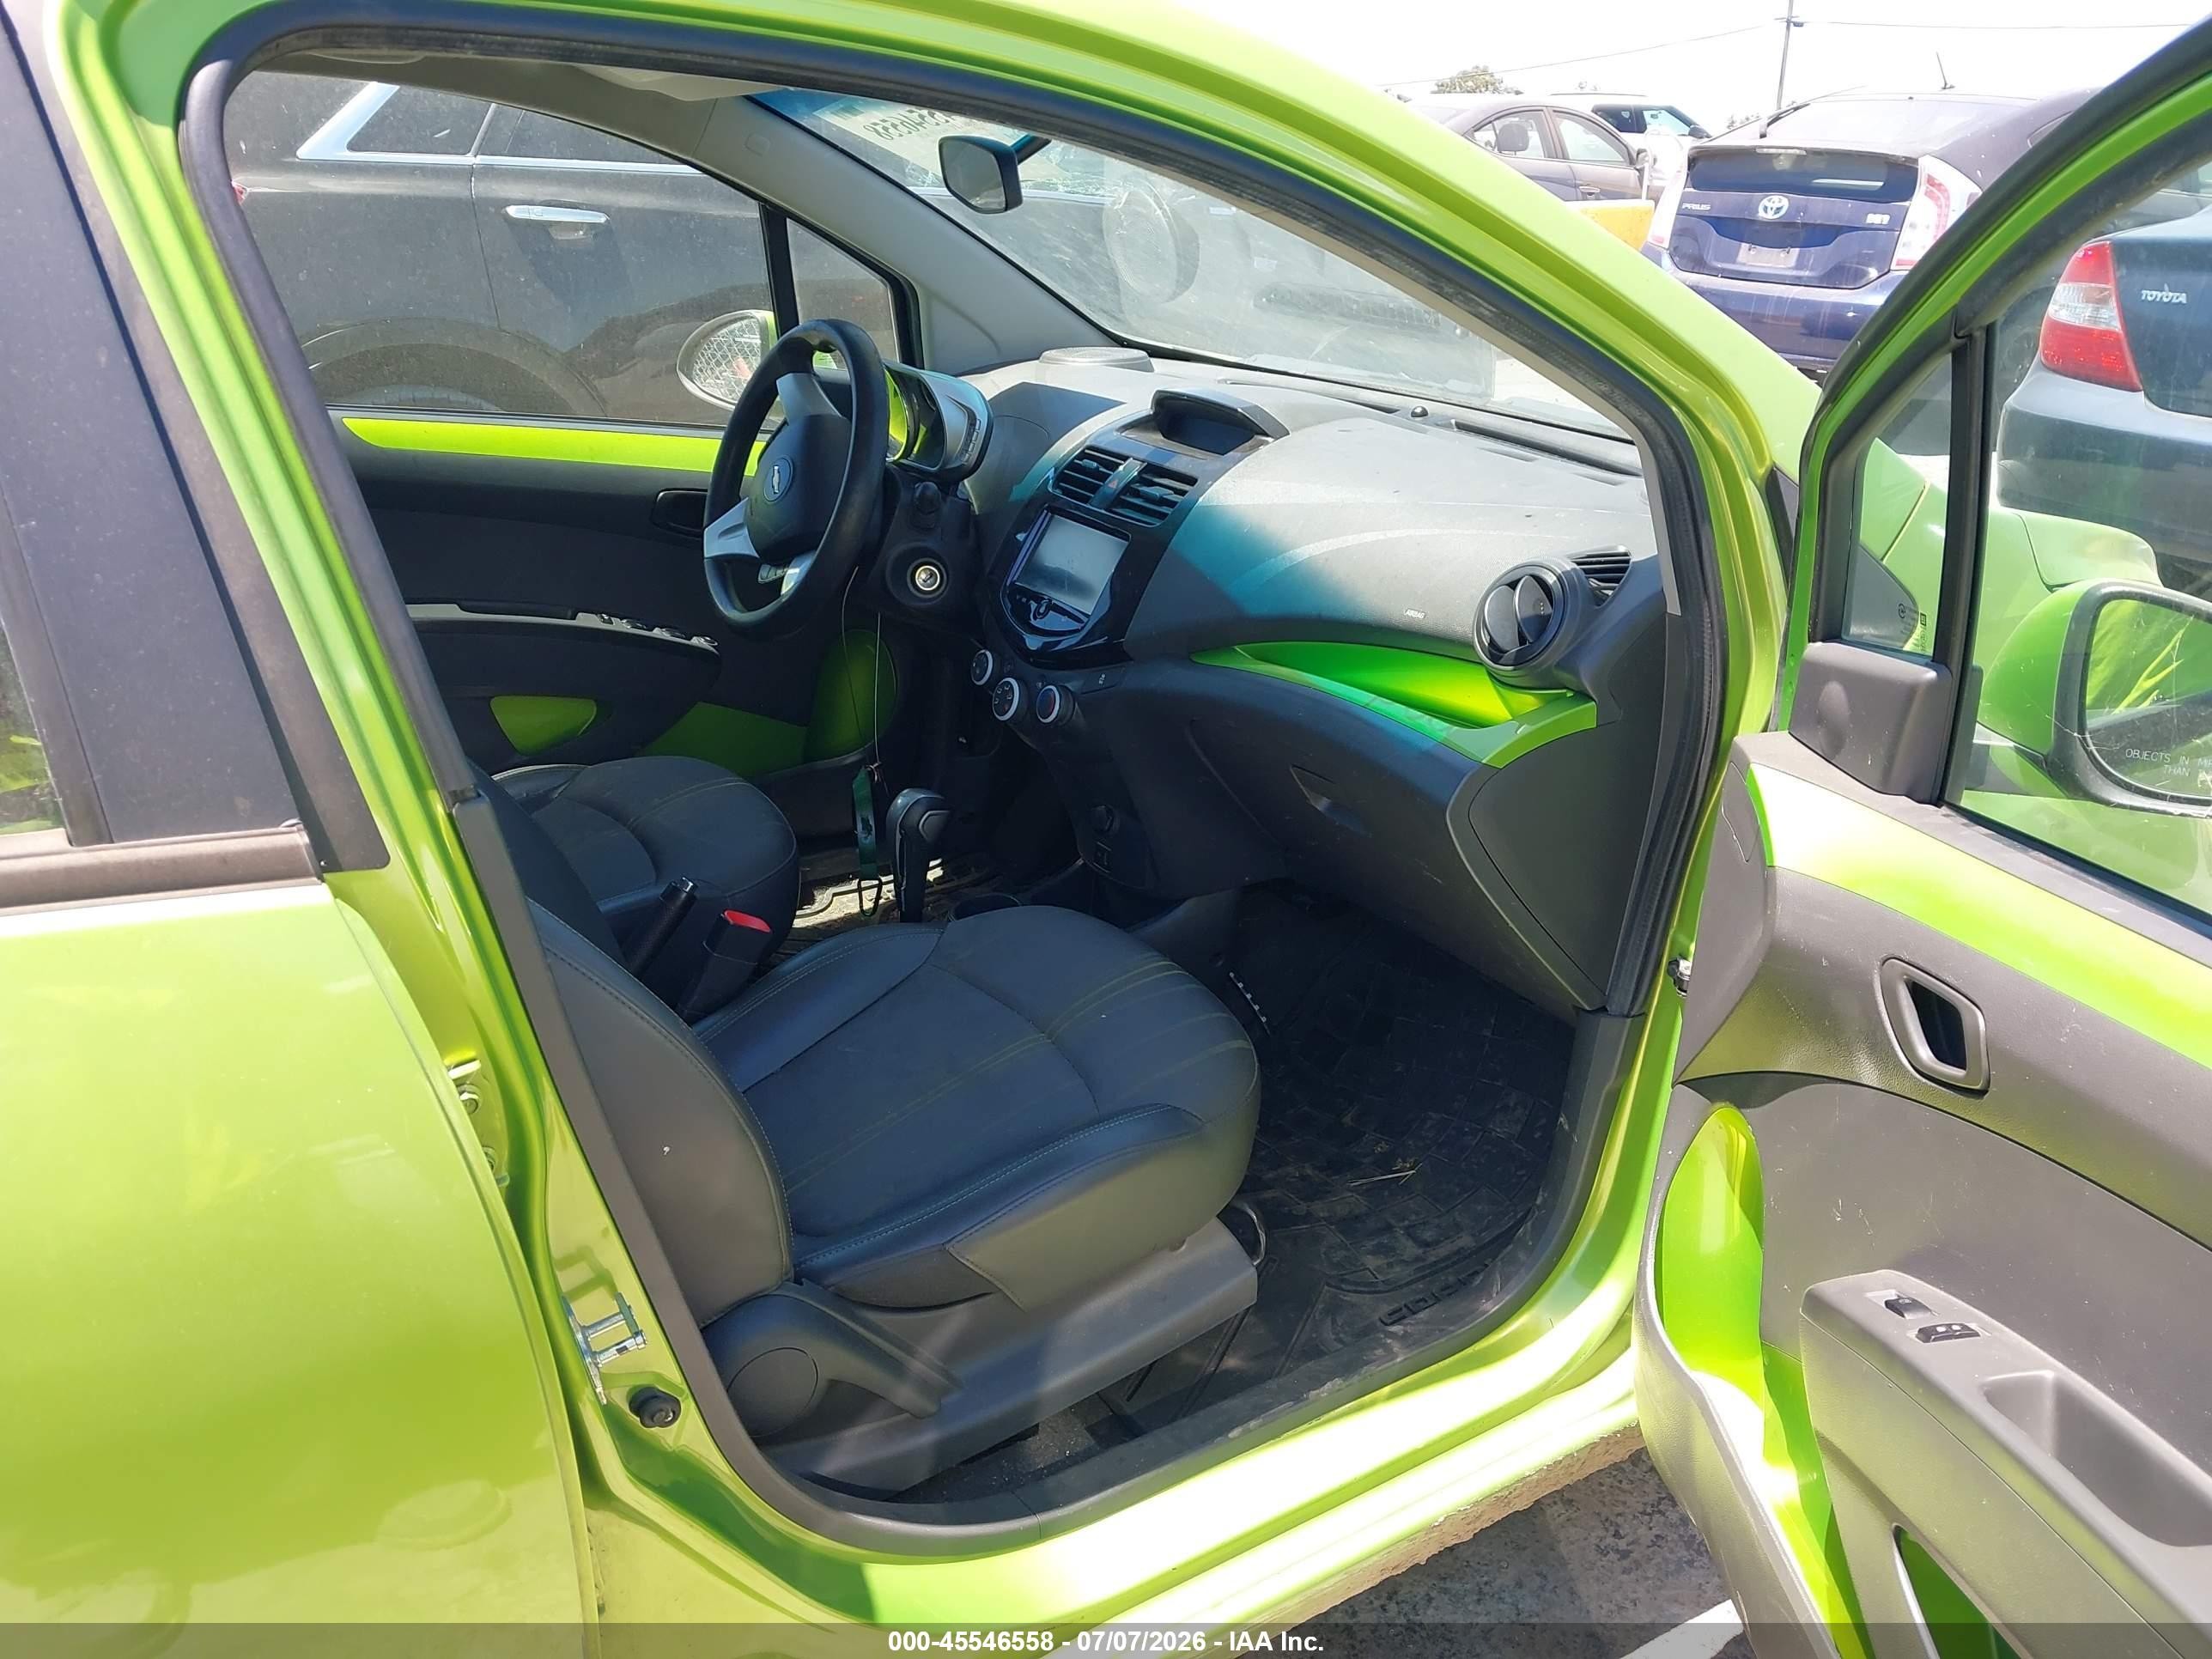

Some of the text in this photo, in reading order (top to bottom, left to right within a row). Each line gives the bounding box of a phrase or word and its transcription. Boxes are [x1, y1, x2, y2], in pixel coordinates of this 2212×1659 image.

[2141, 289, 2187, 303] TOYOTA
[1404, 609, 1425, 619] AIRBAG
[2125, 748, 2171, 763] OBJECTS
[2179, 755, 2191, 765] IN
[2164, 764, 2191, 776] THAN
